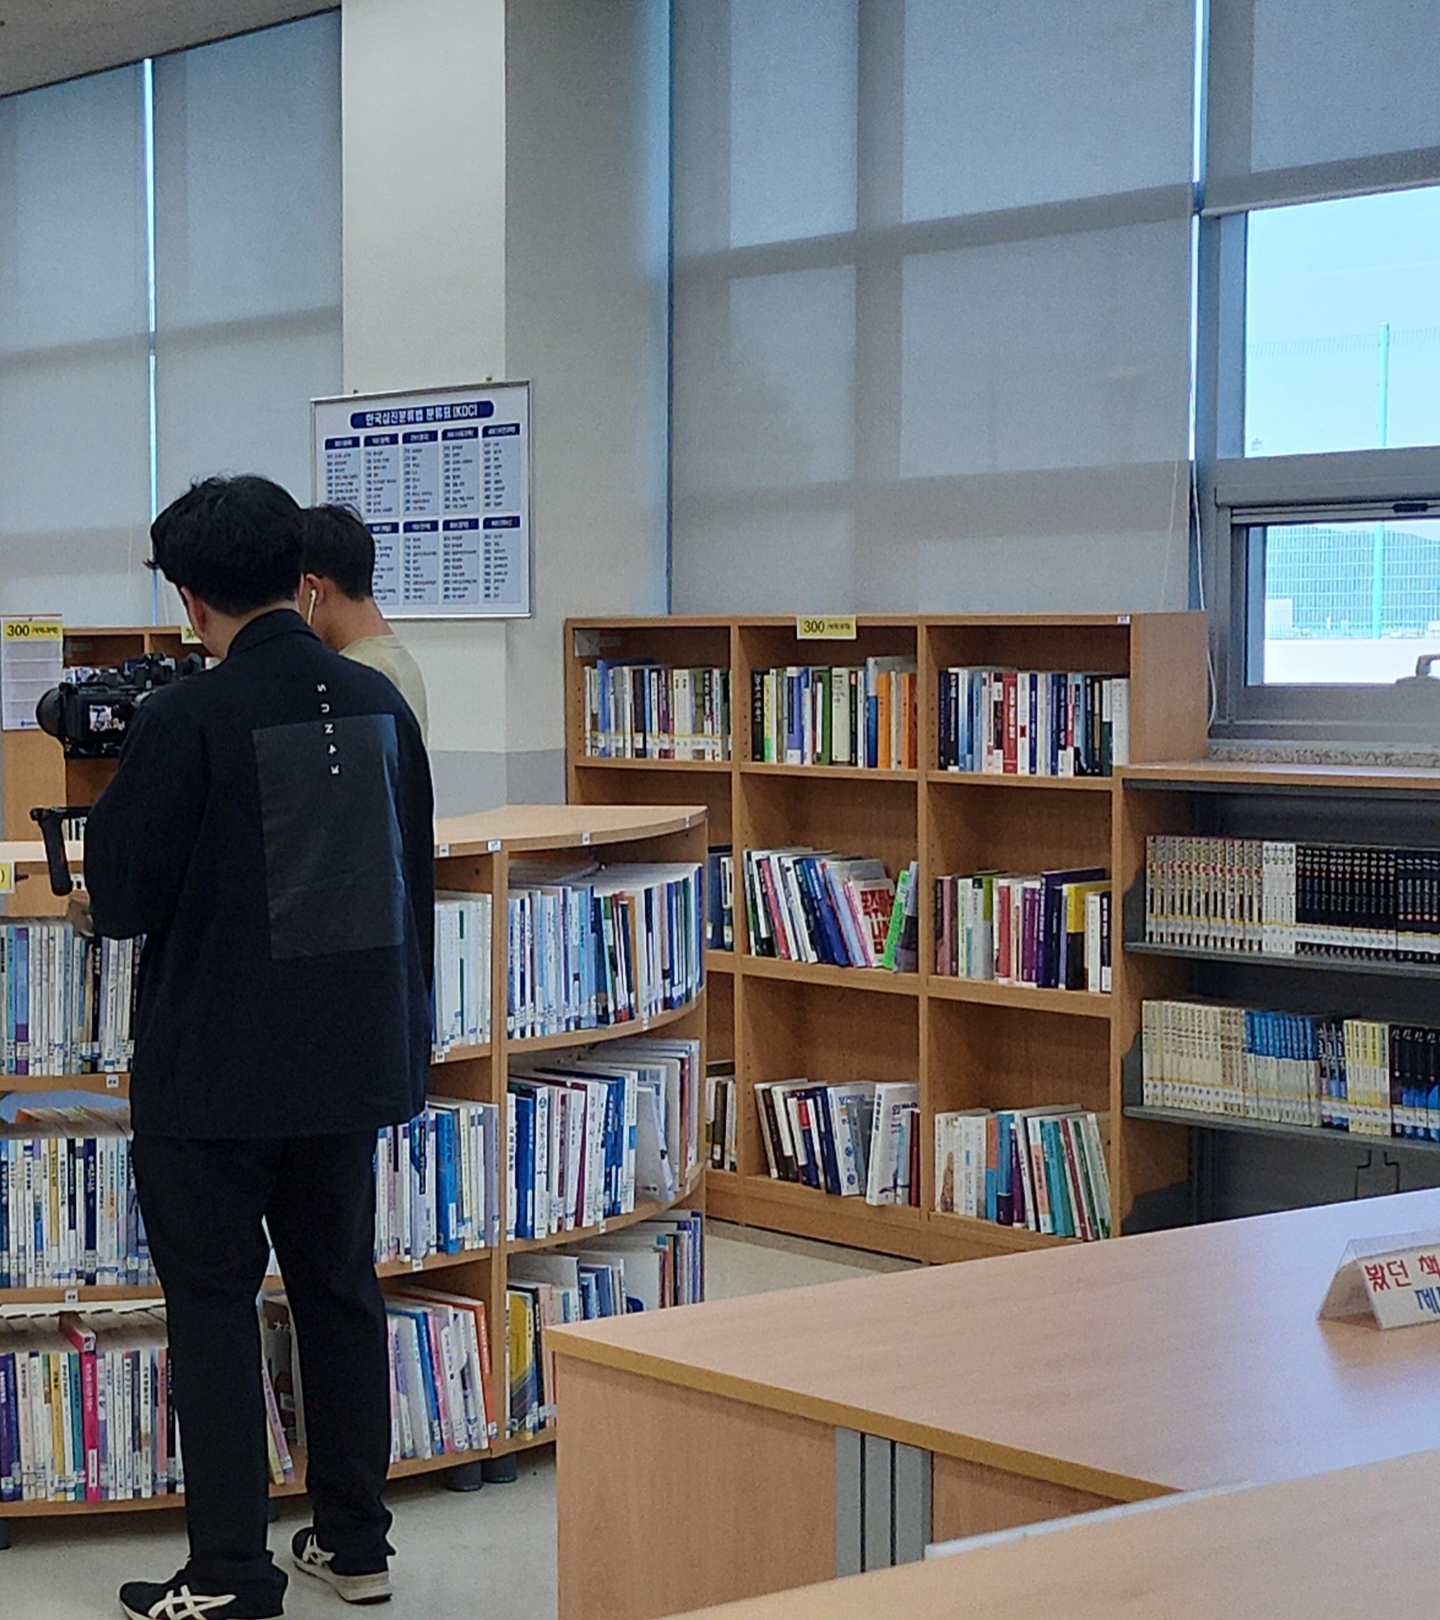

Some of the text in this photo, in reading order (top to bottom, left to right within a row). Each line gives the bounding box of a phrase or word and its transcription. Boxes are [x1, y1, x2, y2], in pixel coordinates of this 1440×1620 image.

[7, 624, 30, 637] 300
[803, 620, 825, 633] 300
[1364, 1260, 1412, 1292] 봤던
